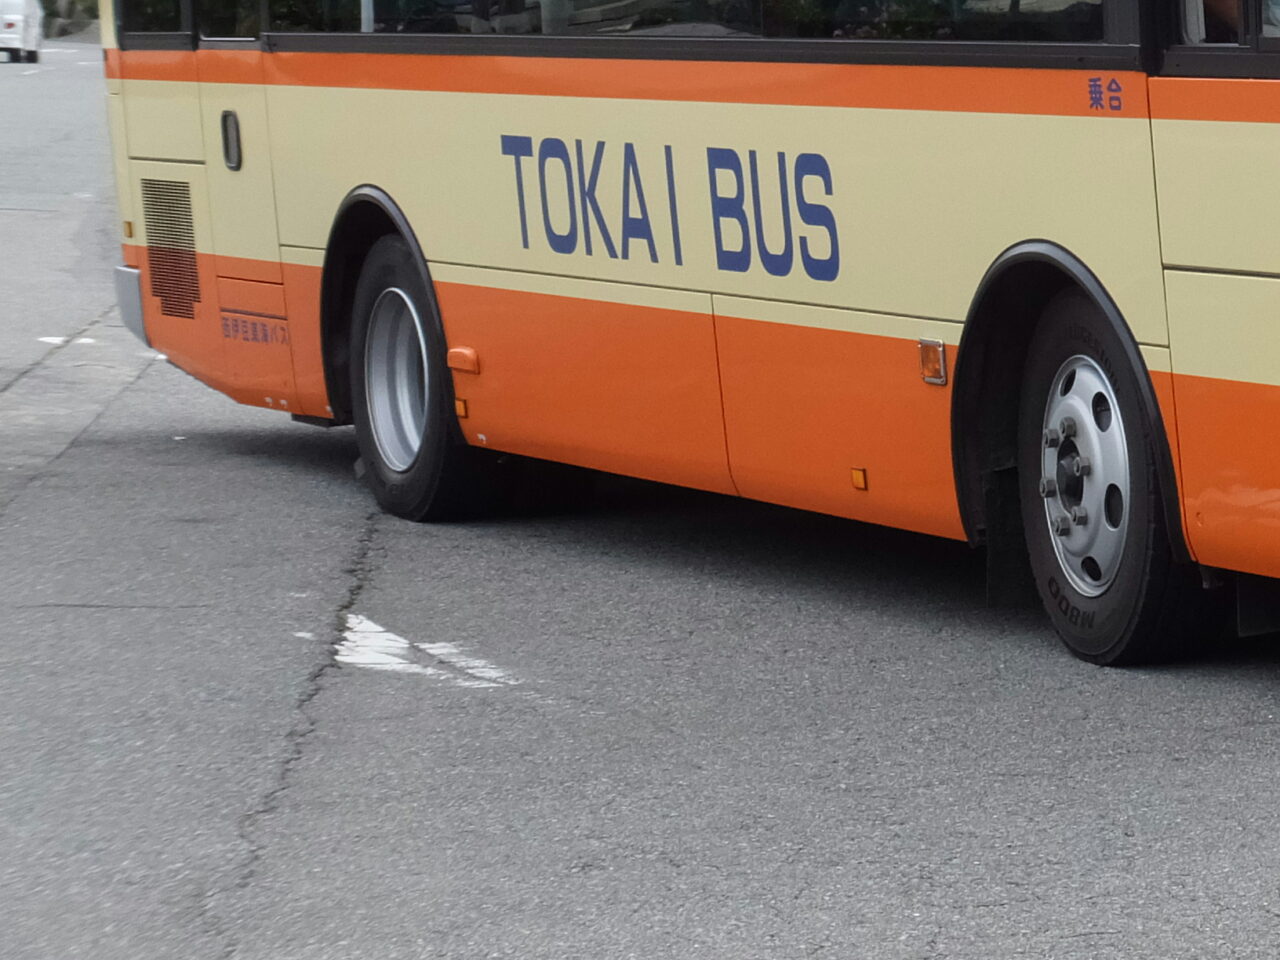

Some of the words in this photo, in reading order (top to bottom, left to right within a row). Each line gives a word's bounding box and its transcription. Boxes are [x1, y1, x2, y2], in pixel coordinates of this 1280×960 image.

[1088, 77, 1122, 112] 乗合
[500, 134, 683, 266] TOKAI
[706, 147, 840, 282] BUS
